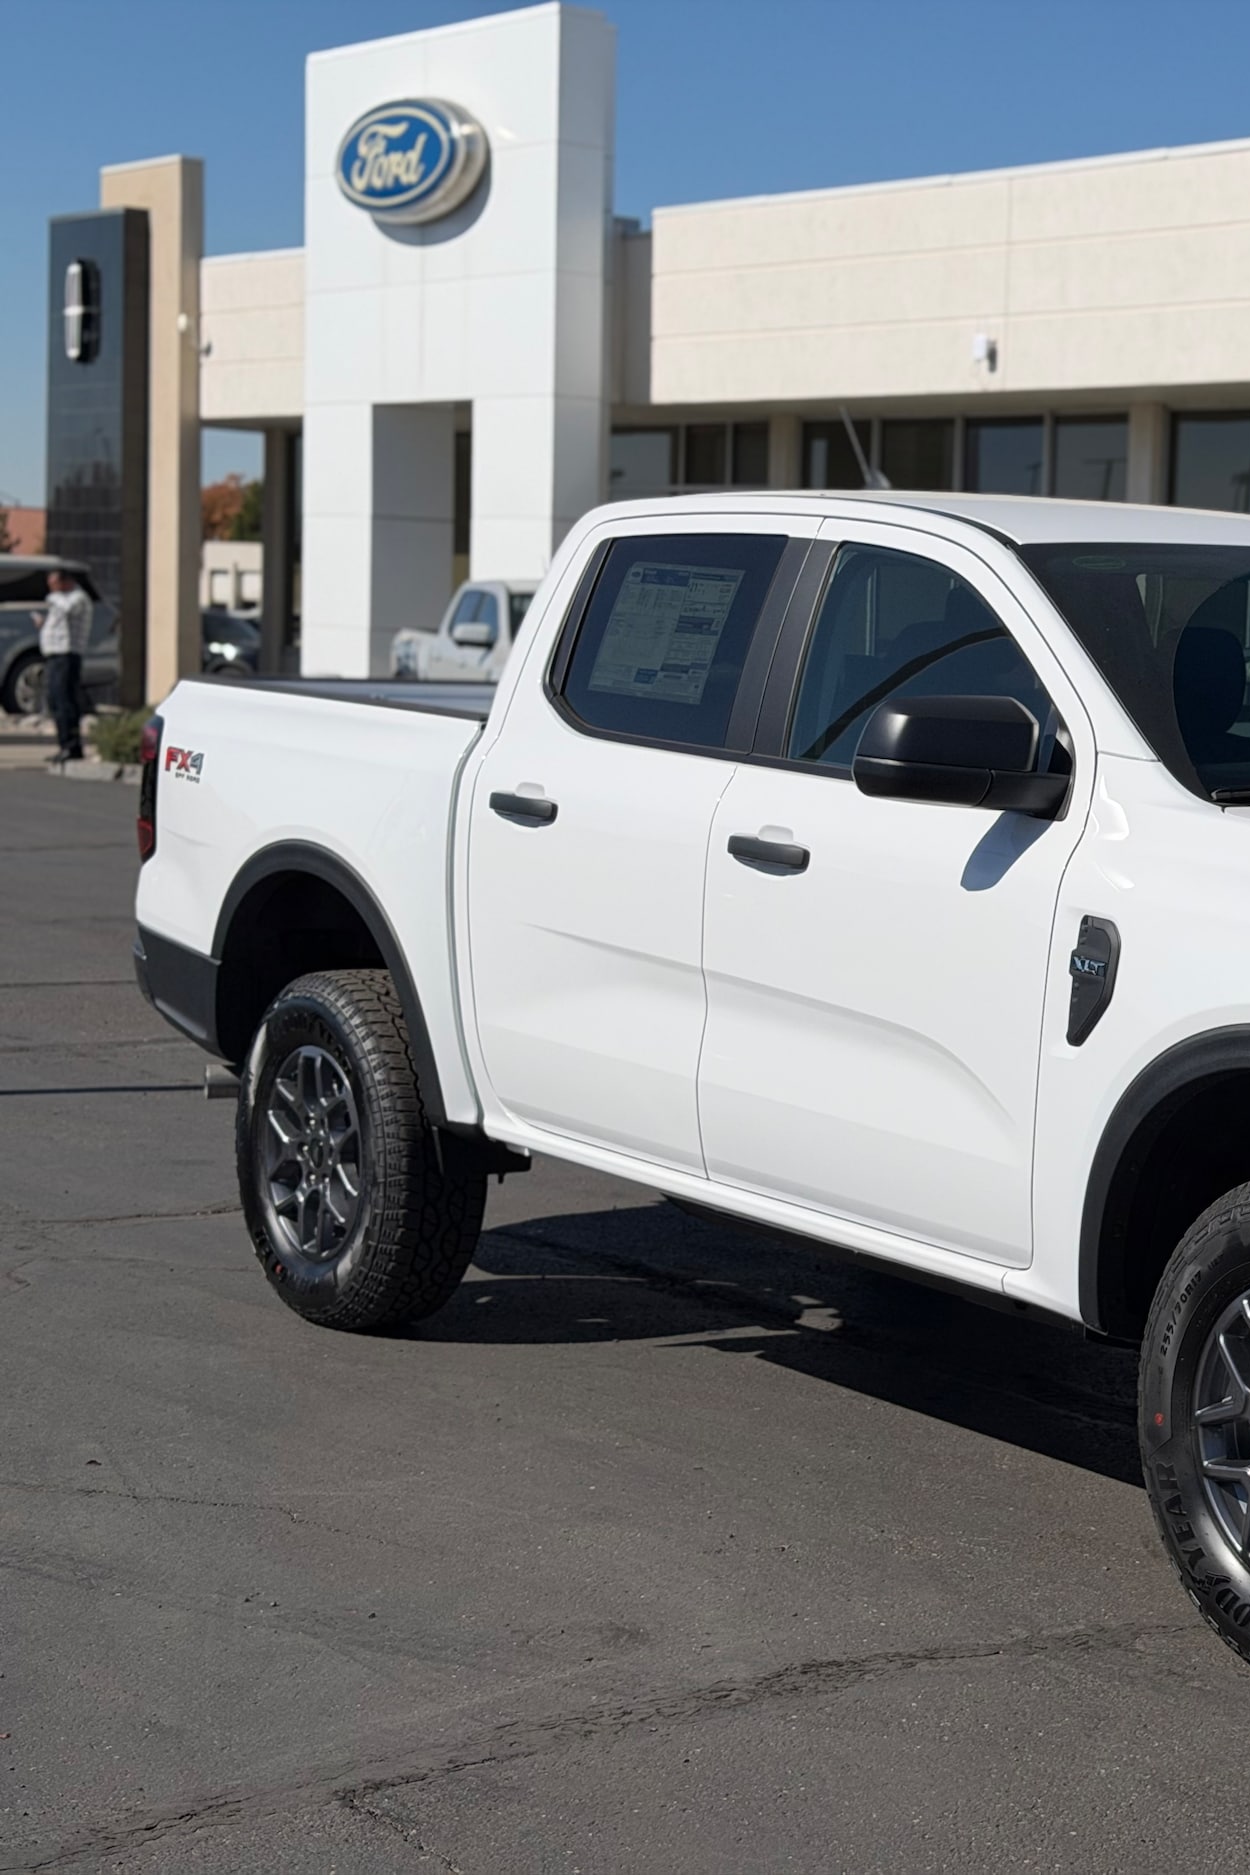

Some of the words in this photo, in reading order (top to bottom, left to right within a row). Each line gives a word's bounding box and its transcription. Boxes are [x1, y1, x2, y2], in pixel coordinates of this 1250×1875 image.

[352, 121, 427, 192] Ford
[165, 746, 204, 775] FX4
[1073, 956, 1105, 976] XLT
[1159, 1270, 1202, 1357] 255/70R17
